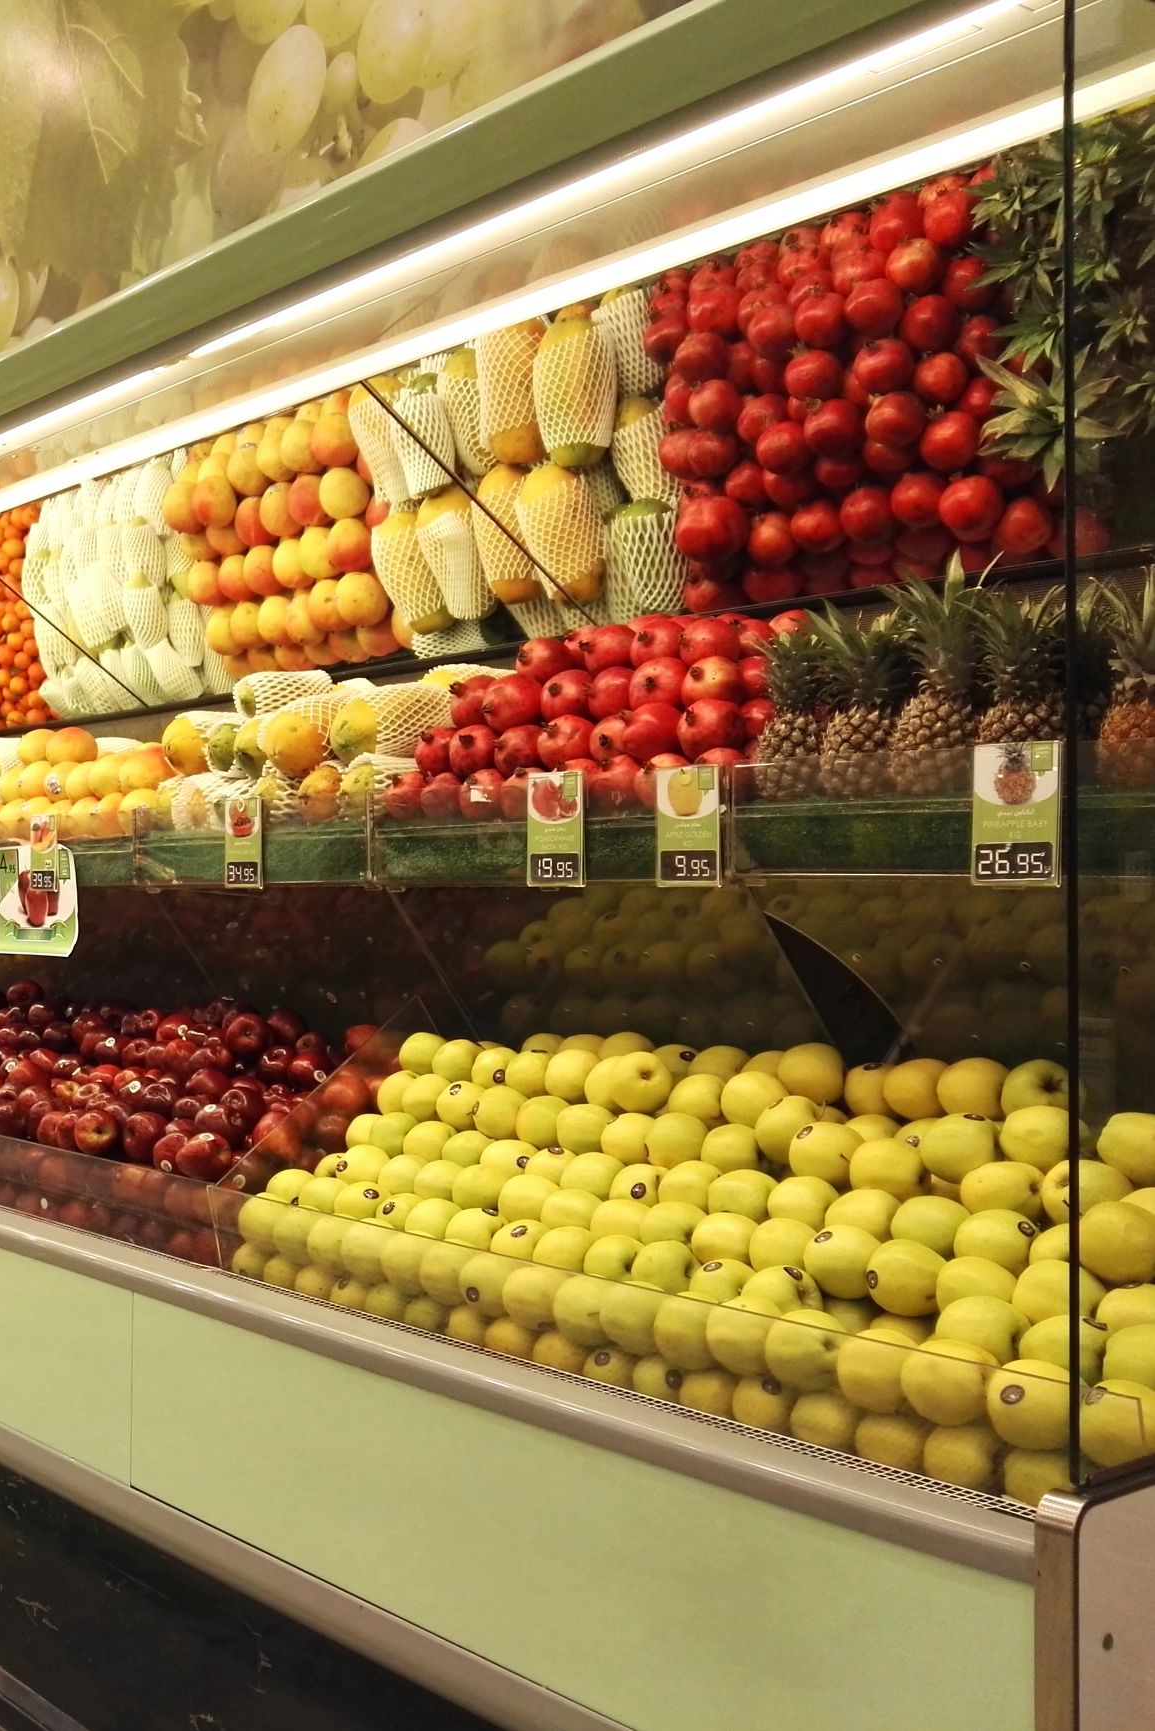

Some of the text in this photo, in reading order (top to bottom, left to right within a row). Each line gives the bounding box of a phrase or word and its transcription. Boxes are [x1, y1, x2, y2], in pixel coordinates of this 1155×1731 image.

[982, 818, 1048, 829] PINEAPPLE BABY
[665, 830, 711, 839] APPLE GOLDEN
[1008, 831, 1022, 840] KG
[0, 853, 16, 875] 4.95
[538, 857, 573, 878] 19.95
[675, 855, 710, 877] 9.95
[978, 848, 1045, 875] 26.95
[32, 873, 52, 888] 39.95
[228, 865, 255, 882] 34.95
